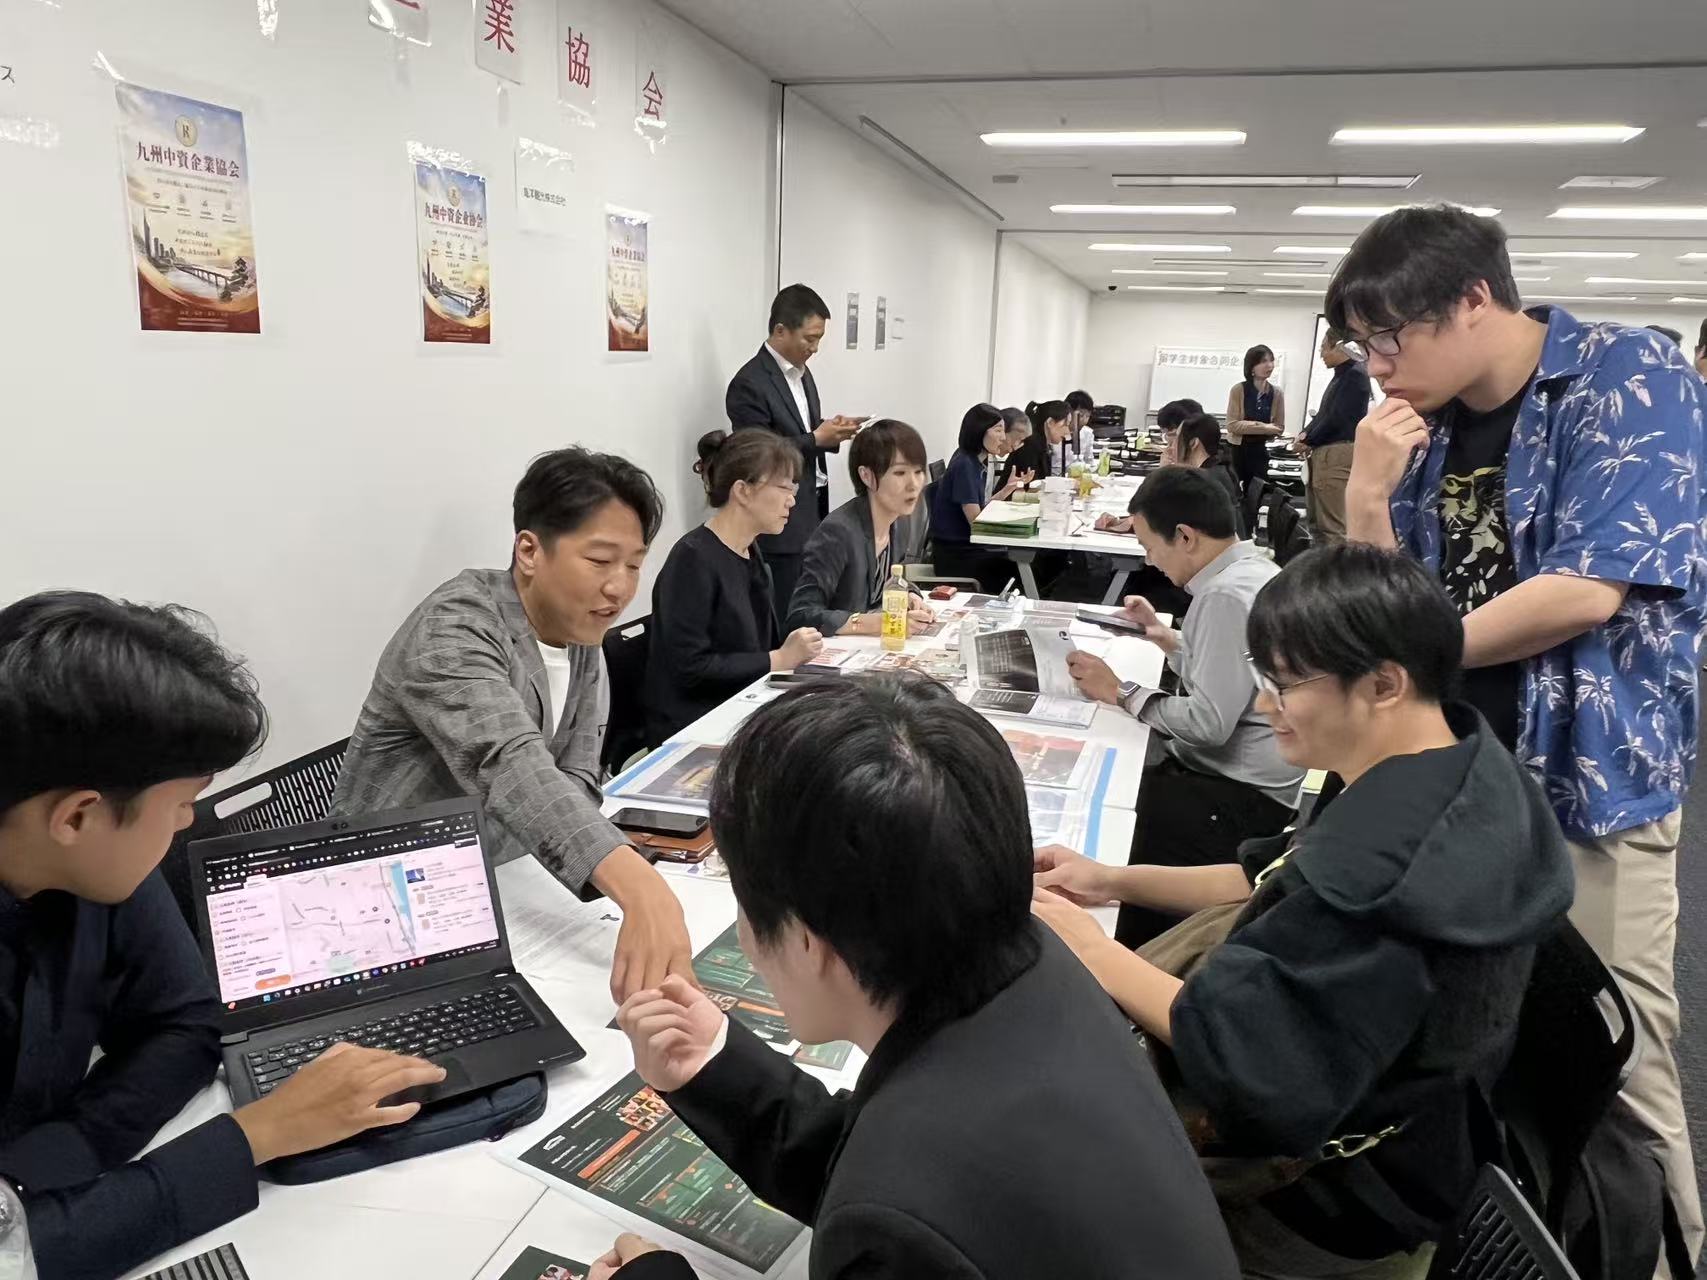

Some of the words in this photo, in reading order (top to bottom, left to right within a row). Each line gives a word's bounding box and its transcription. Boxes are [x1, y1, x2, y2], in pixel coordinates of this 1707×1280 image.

[484, 0, 515, 53] 業
[565, 26, 591, 88] 協
[642, 70, 663, 120] 会
